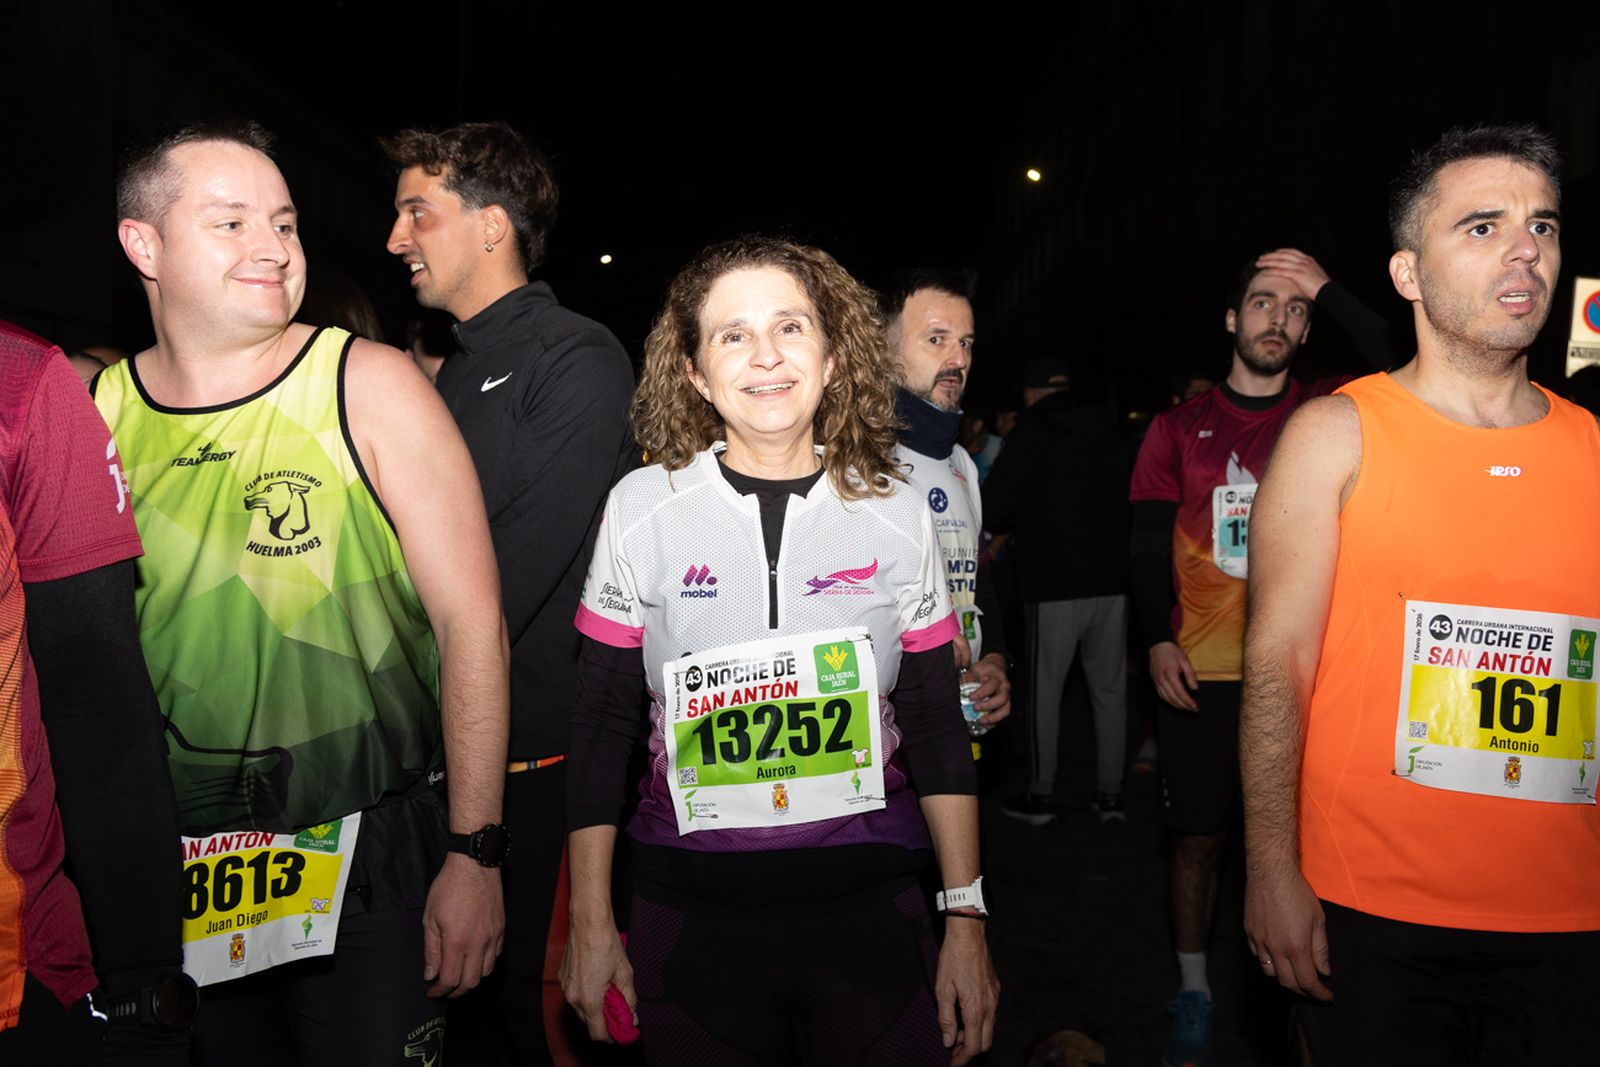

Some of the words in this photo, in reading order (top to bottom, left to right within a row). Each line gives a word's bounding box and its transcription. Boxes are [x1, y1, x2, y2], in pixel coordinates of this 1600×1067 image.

[244, 473, 263, 492] CLUB
[264, 471, 274, 481] DE
[276, 470, 323, 488] ATLETISMO
[246, 540, 293, 557] HUELMA
[295, 536, 322, 555] 2003
[680, 589, 717, 598] mobel
[1429, 619, 1450, 634] 43
[1456, 618, 1483, 627] CARRERA
[1508, 624, 1553, 633] INTERNACIONAL
[1455, 627, 1524, 649] NOCHE
[1527, 634, 1554, 652] DE
[704, 660, 729, 670] CARRERA
[1428, 646, 1471, 667] SAN
[1476, 650, 1552, 677] ANTÓN
[686, 669, 702, 686] 43
[706, 662, 769, 689] NOCHE
[773, 658, 796, 678] DE
[686, 691, 726, 718] SAN
[730, 678, 799, 706] ANTÓN
[1471, 676, 1562, 737] 161
[691, 698, 854, 766] 13252
[1489, 735, 1539, 753] Antonio
[756, 764, 796, 780] Aurora
[183, 850, 306, 920] 8613
[206, 917, 233, 934] Juan
[236, 909, 269, 927] Diego
